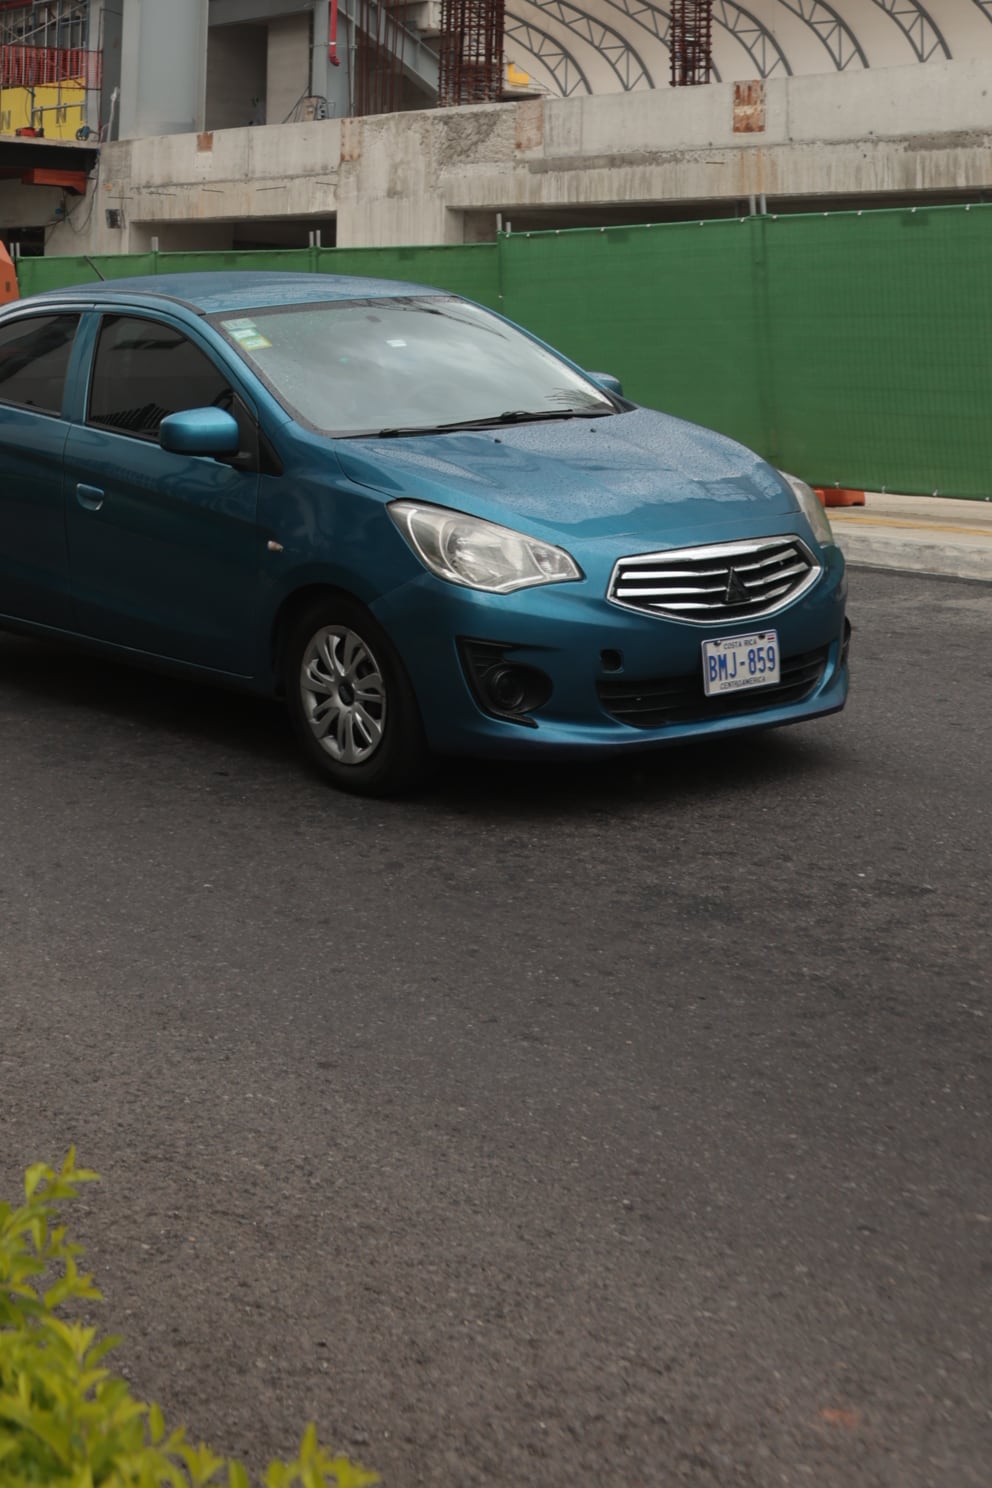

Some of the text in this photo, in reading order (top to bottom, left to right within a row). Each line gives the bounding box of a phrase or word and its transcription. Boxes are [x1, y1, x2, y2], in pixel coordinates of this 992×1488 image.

[723, 638, 757, 650] COSTA RICA
[708, 645, 776, 683] BMJ-859
